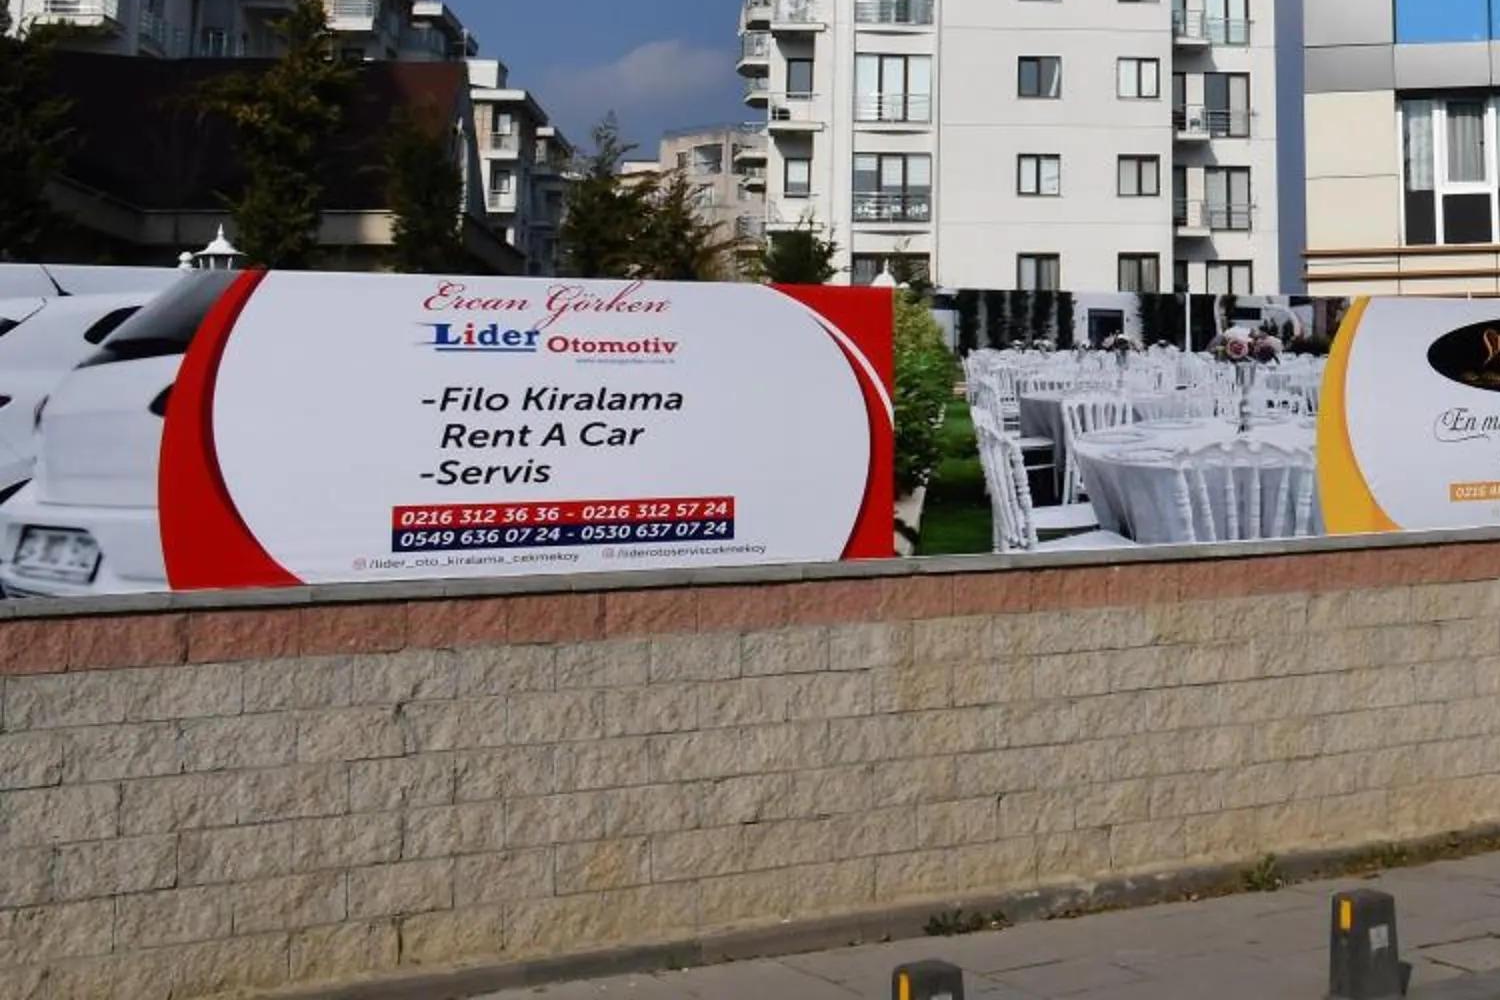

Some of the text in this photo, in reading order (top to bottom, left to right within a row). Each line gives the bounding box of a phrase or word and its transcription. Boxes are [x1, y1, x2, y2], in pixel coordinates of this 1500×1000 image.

[423, 280, 671, 330] Ercan Görken
[435, 323, 678, 354] Lider Otomotiv
[421, 387, 684, 412] -Filo Kiralama
[441, 421, 645, 449] Rent A Car
[420, 459, 552, 485] -Servis
[401, 510, 453, 526] 0216
[459, 509, 497, 525] 312
[503, 507, 528, 522] 36
[533, 506, 560, 521] 36
[582, 505, 630, 520] 0216
[636, 504, 671, 518] 312
[676, 503, 699, 517] 57
[704, 502, 727, 516] 24
[401, 531, 454, 547] 0549
[460, 529, 499, 544] 636
[505, 528, 532, 543] 07
[535, 527, 561, 542] 24
[581, 525, 631, 540] 0530
[636, 524, 672, 538] 637
[676, 522, 700, 537] 07
[704, 521, 727, 535] 24
